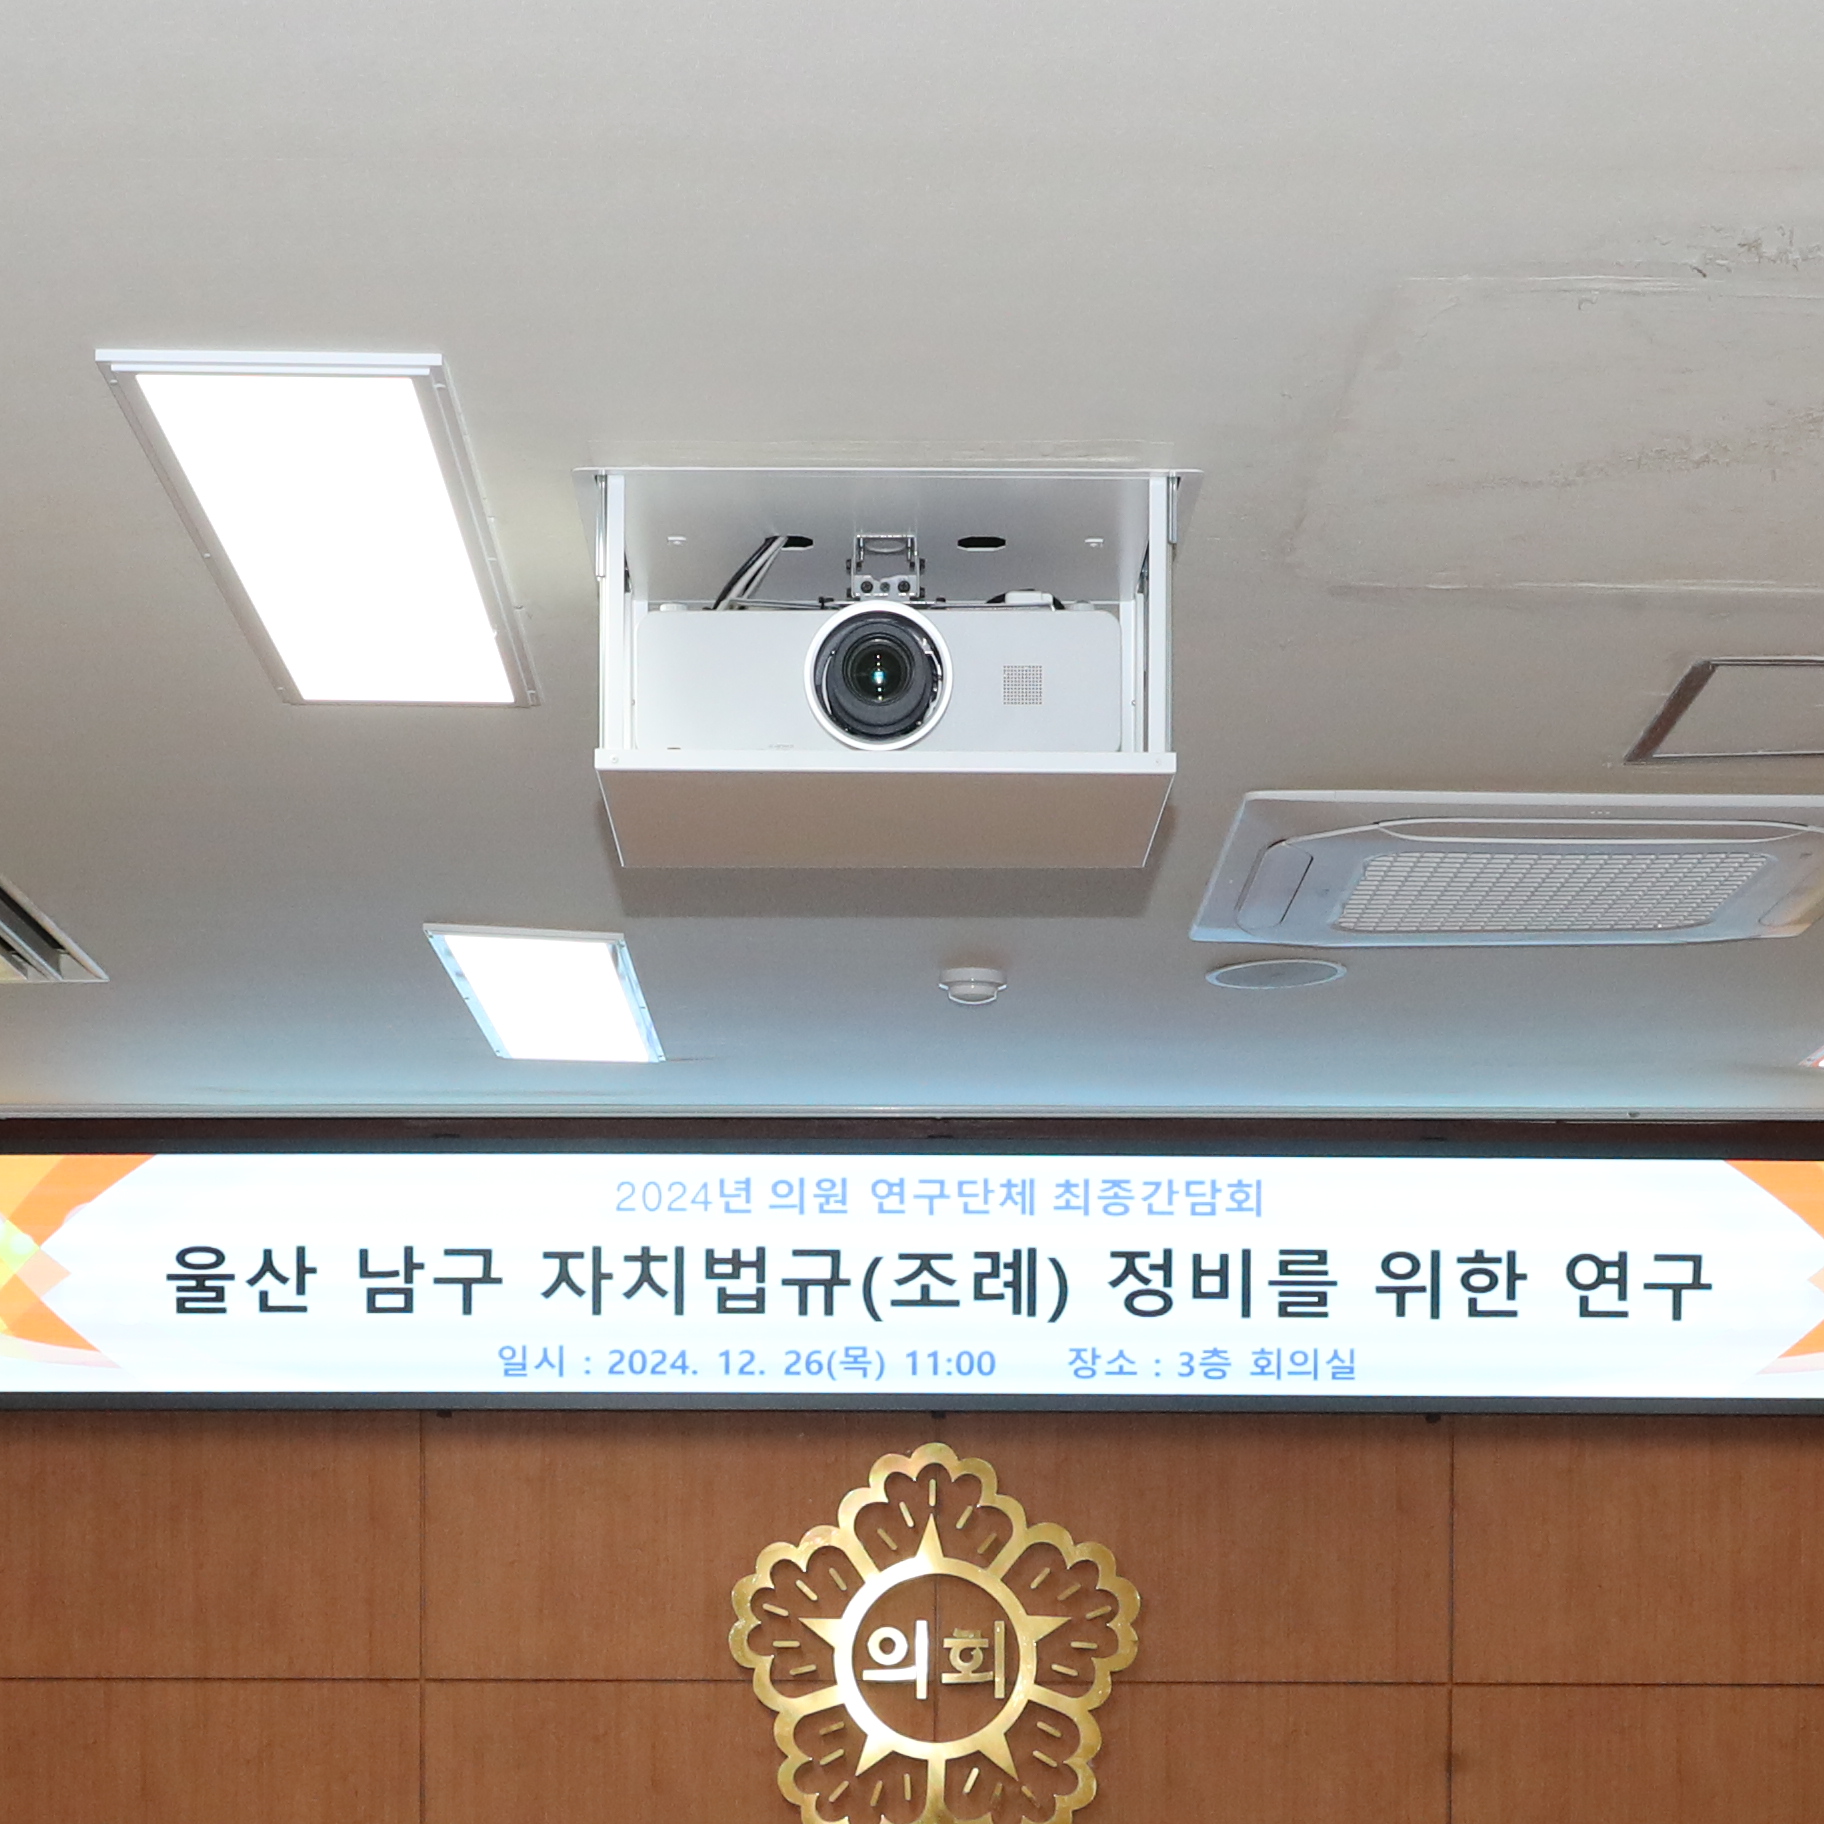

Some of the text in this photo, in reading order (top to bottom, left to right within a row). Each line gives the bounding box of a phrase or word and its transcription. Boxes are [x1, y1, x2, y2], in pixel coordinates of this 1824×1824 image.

[615, 1177, 1262, 1218] 2024년 의원 연구단체 최종간담회
[166, 1245, 1713, 1323] 울산 남구 자치법규(조례) 정비를 위한 연구
[498, 1344, 564, 1378] 일시
[607, 1349, 699, 1376] 2024.
[718, 1349, 766, 1376] 12.
[783, 1345, 886, 1382] 26(목)
[906, 1349, 996, 1377] 11:00
[1068, 1346, 1138, 1380] 장소
[1177, 1347, 1232, 1381] 3층
[1249, 1347, 1356, 1382] 회의실
[861, 1619, 1006, 1701] 의회
